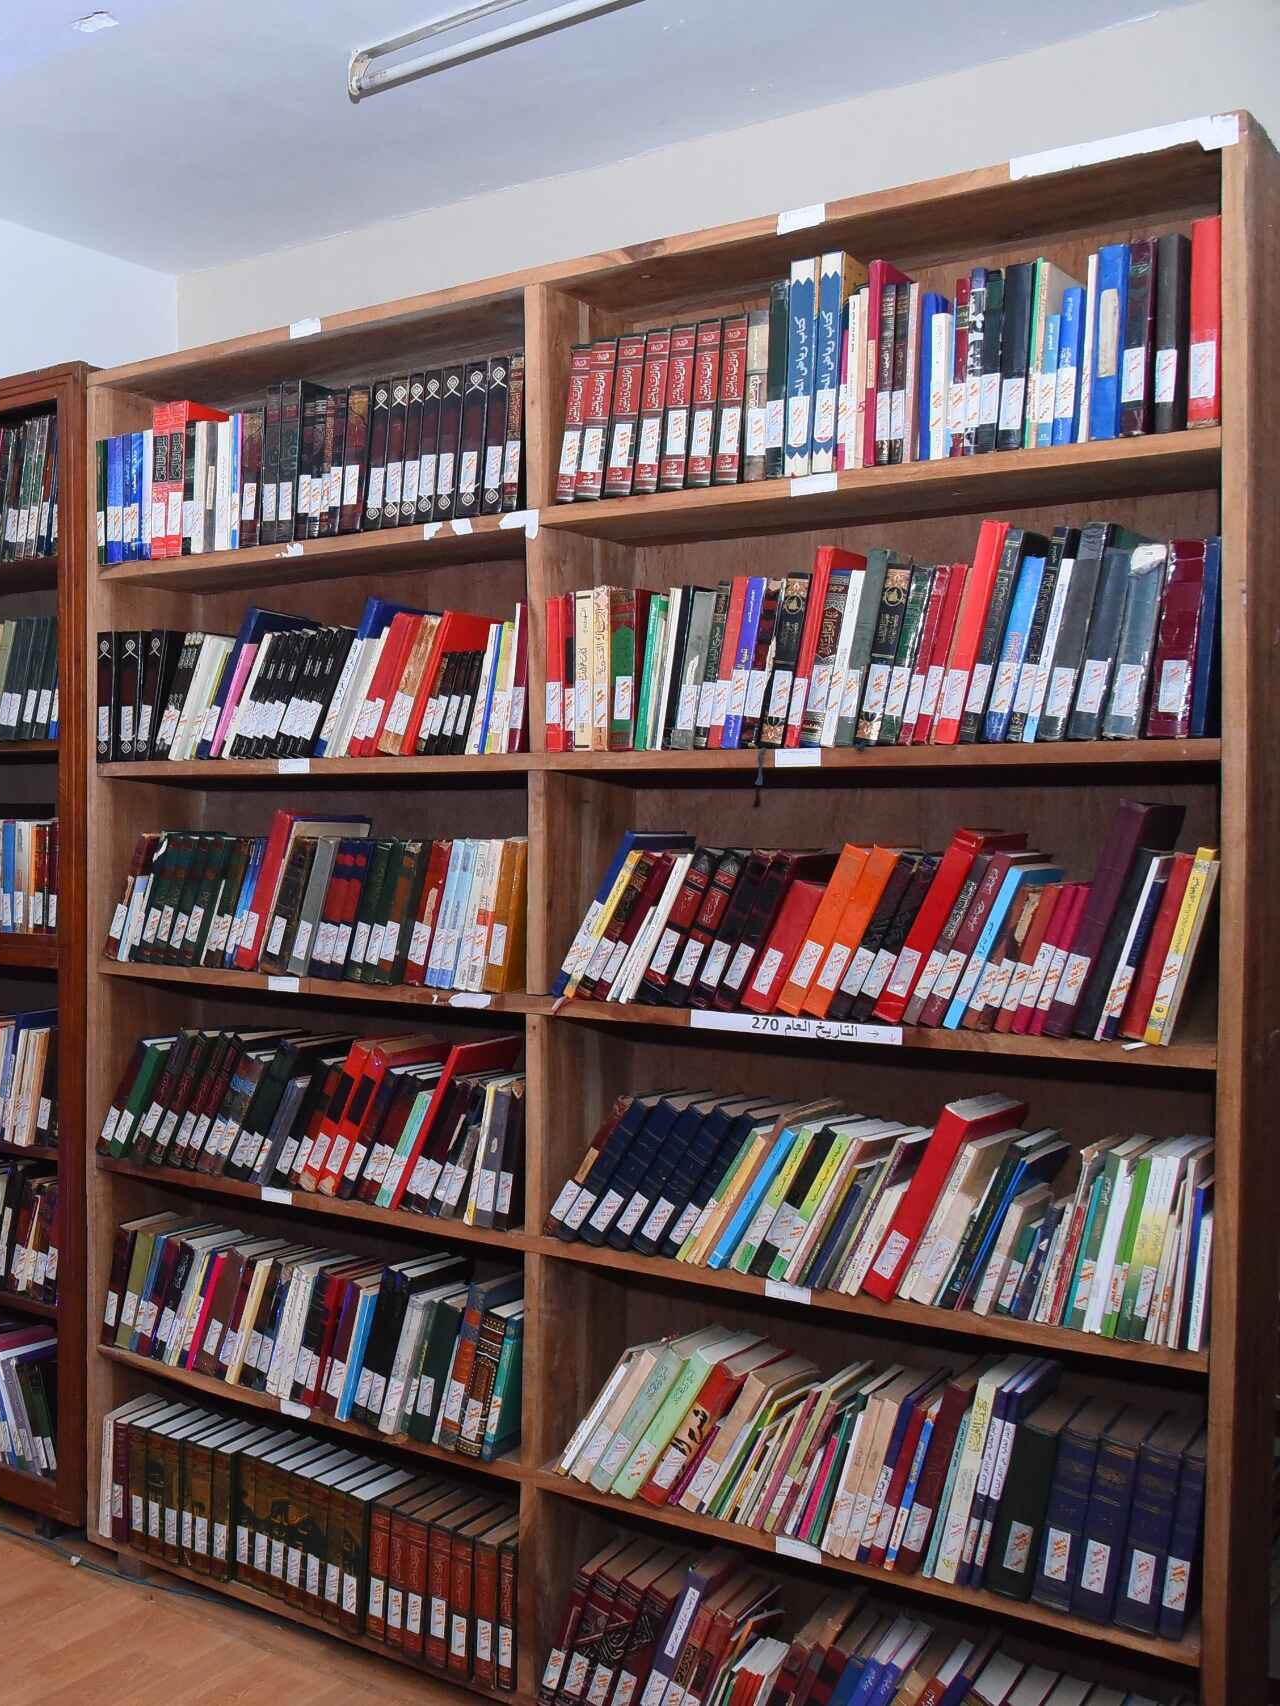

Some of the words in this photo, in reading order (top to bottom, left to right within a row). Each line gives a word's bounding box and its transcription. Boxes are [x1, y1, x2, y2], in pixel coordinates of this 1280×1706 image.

[793, 316, 808, 344] كتاب
[821, 311, 835, 338] كتاب
[796, 346, 809, 376] رياض
[824, 341, 835, 370] رياض
[752, 1016, 778, 1031] 270
[784, 1021, 810, 1034] العام
[815, 1022, 857, 1038] التاريخ
[686, 1409, 708, 1446] شرح
